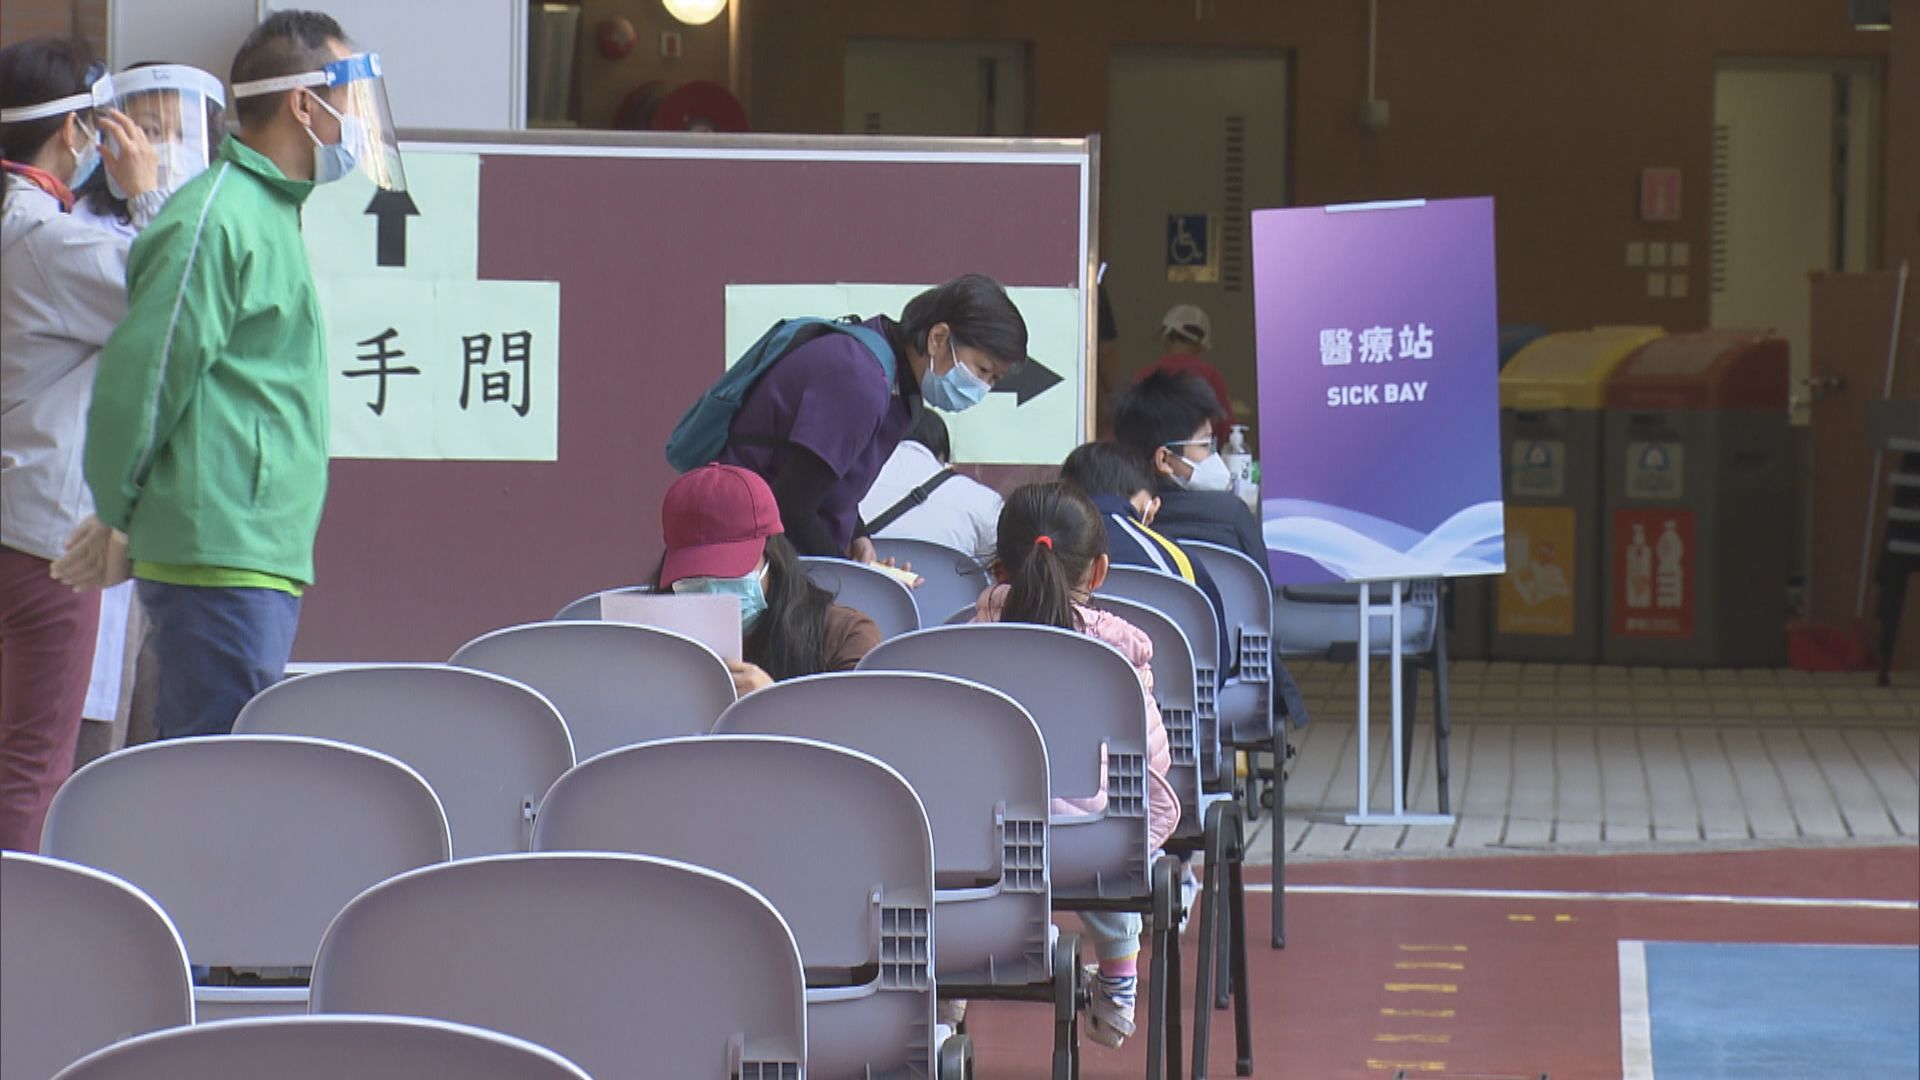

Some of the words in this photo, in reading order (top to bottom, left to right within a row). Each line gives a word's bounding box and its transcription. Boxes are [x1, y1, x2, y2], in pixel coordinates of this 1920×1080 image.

[1319, 323, 1433, 365] 醫療站
[1326, 384, 1379, 407] SICK
[1384, 381, 1428, 403] BAY
